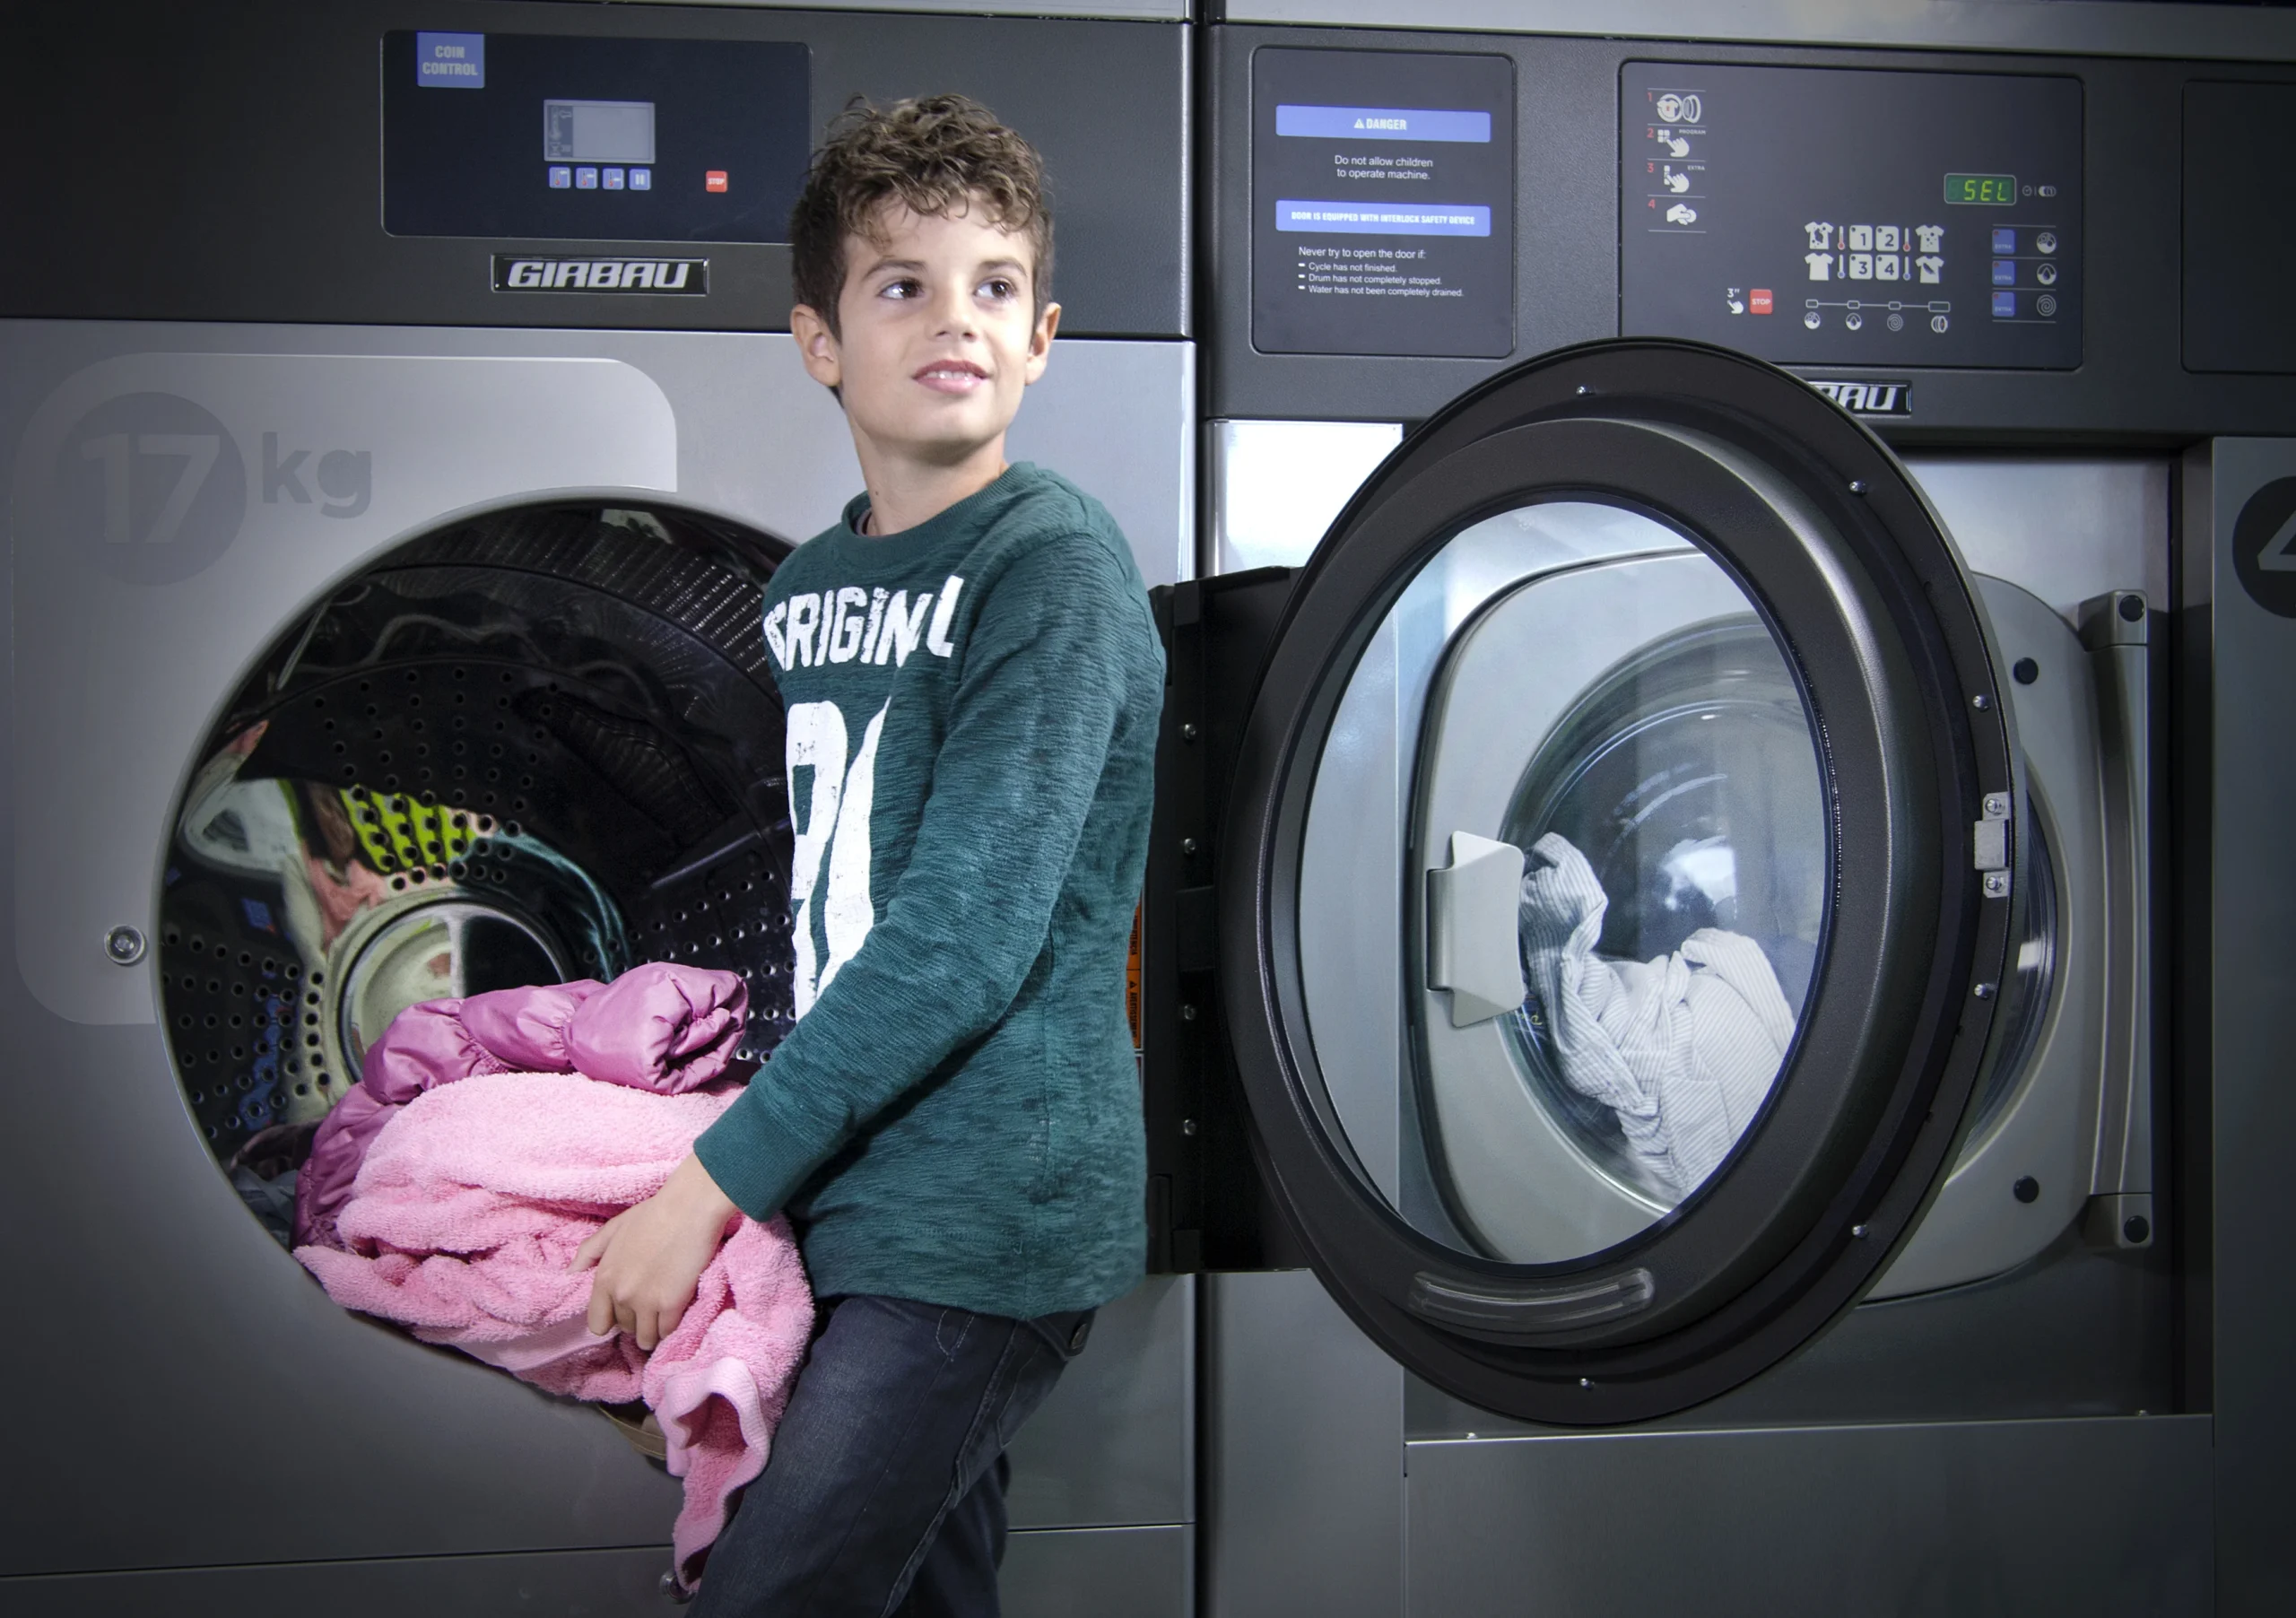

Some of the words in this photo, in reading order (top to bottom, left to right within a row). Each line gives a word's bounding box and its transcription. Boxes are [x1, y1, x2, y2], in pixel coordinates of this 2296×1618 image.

[435, 46, 465, 59] COIN
[422, 62, 479, 76] CONTROL
[1648, 92, 1653, 101] 1
[1366, 118, 1407, 130] DANGER
[1647, 128, 1654, 138] 2
[1335, 155, 1349, 165] Do
[1351, 157, 1367, 166] not
[1369, 156, 1394, 166] allow
[1395, 158, 1433, 168] children
[1647, 163, 1654, 173] 3
[1336, 169, 1347, 178] to
[1348, 169, 1386, 179] operate
[1387, 170, 1431, 180] machine.
[708, 178, 725, 186] STOP
[1963, 180, 2007, 202] SEL
[1648, 199, 1656, 209] 4
[1292, 212, 1312, 221] DOOR
[1313, 213, 1321, 221] IS
[1322, 213, 1359, 222] EQUIPPED
[1360, 213, 1379, 222] WITH
[1380, 214, 1420, 223] INTERLOCK
[1421, 215, 1448, 224] SAFETY
[1449, 216, 1475, 225] DEVICE
[1860, 233, 1866, 247] 1
[1885, 233, 1894, 247] 2
[1299, 247, 1326, 257] Never
[1327, 248, 1340, 259] try
[1342, 248, 1352, 257] to
[1352, 250, 1377, 259] open
[1378, 248, 1393, 258] the
[1395, 249, 1416, 259] door
[1417, 249, 1427, 259] if:
[1309, 262, 1331, 272] Cycle
[1333, 263, 1348, 271] has
[1350, 264, 1363, 272] not
[1364, 264, 1398, 273] finished.
[1858, 261, 1867, 274] 3
[1884, 262, 1894, 276] 4
[509, 262, 689, 289] GIRBAU
[1309, 274, 1331, 282] Drum
[1332, 274, 1348, 283] has
[1349, 275, 1362, 283] not
[1363, 276, 1407, 285] completely
[1408, 277, 1442, 285] stopped.
[1309, 285, 1333, 293] Water
[1334, 286, 1349, 294] has
[1365, 287, 1386, 295] been
[1387, 288, 1431, 298] completely
[1431, 289, 1464, 297] drained.
[81, 433, 221, 543] 17
[263, 431, 371, 519] kg
